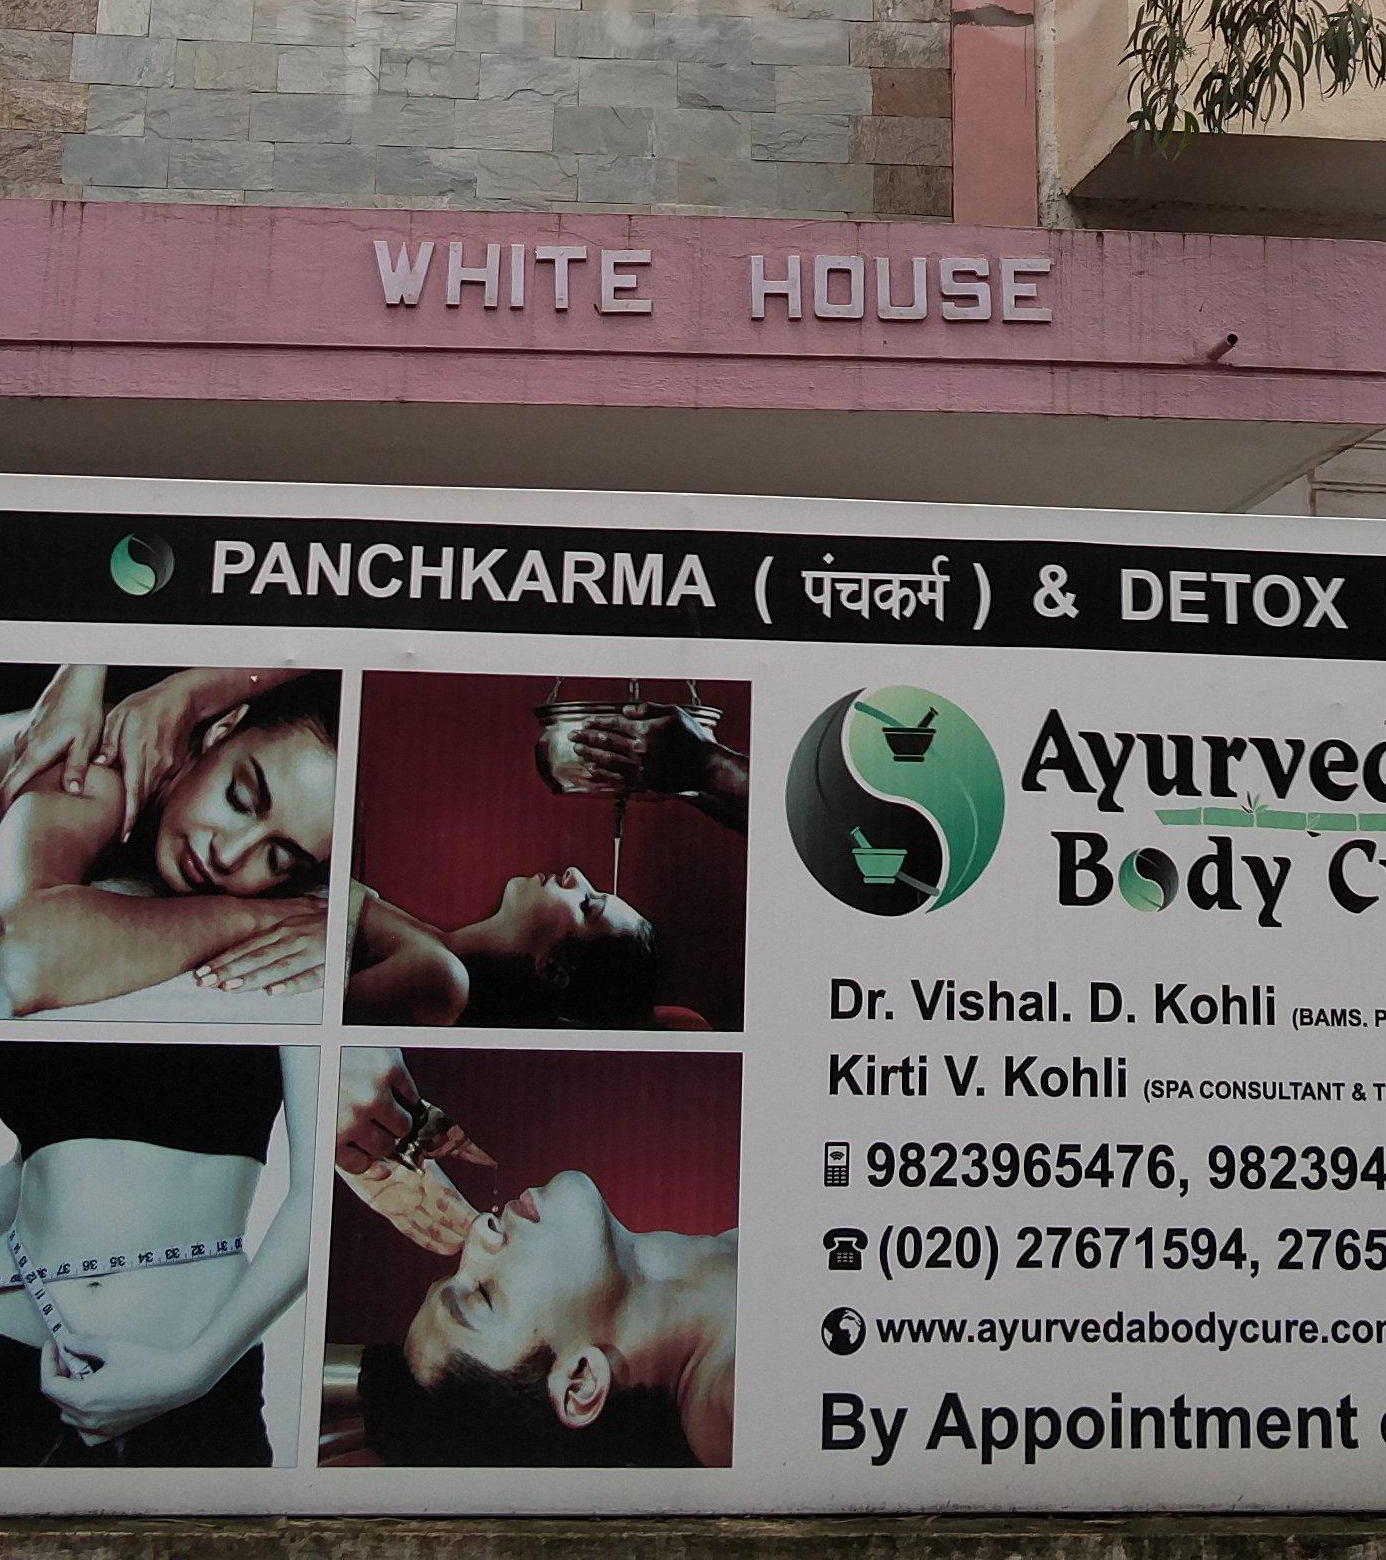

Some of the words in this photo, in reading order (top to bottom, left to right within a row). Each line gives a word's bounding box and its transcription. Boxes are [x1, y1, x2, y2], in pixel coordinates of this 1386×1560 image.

[373, 239, 652, 314] WHITE
[751, 254, 1052, 322] HOUSE
[212, 541, 716, 606] PANCHKARMA
[1033, 565, 1079, 618] &
[1121, 569, 1348, 629] DETOX
[1050, 830, 1292, 927] Body
[831, 979, 893, 1019] Dr.
[911, 980, 1071, 1022] Vishal.
[1091, 982, 1135, 1023] D.
[1156, 984, 1275, 1025] Kohli
[1293, 1008, 1367, 1030] (BAMS.
[830, 1054, 927, 1096] Kirti
[944, 1055, 984, 1096] V.
[1005, 1056, 1126, 1097] Kohli
[1144, 1079, 1194, 1103] (SPA
[1200, 1081, 1345, 1100] CONSULTANT
[1352, 1083, 1366, 1101] &
[867, 1142, 1188, 1197] 9823965476,
[880, 1226, 998, 1280] (020)
[1016, 1227, 1259, 1278] 27671594,
[822, 1393, 908, 1466] By
[926, 1392, 1359, 1464] Appointment
